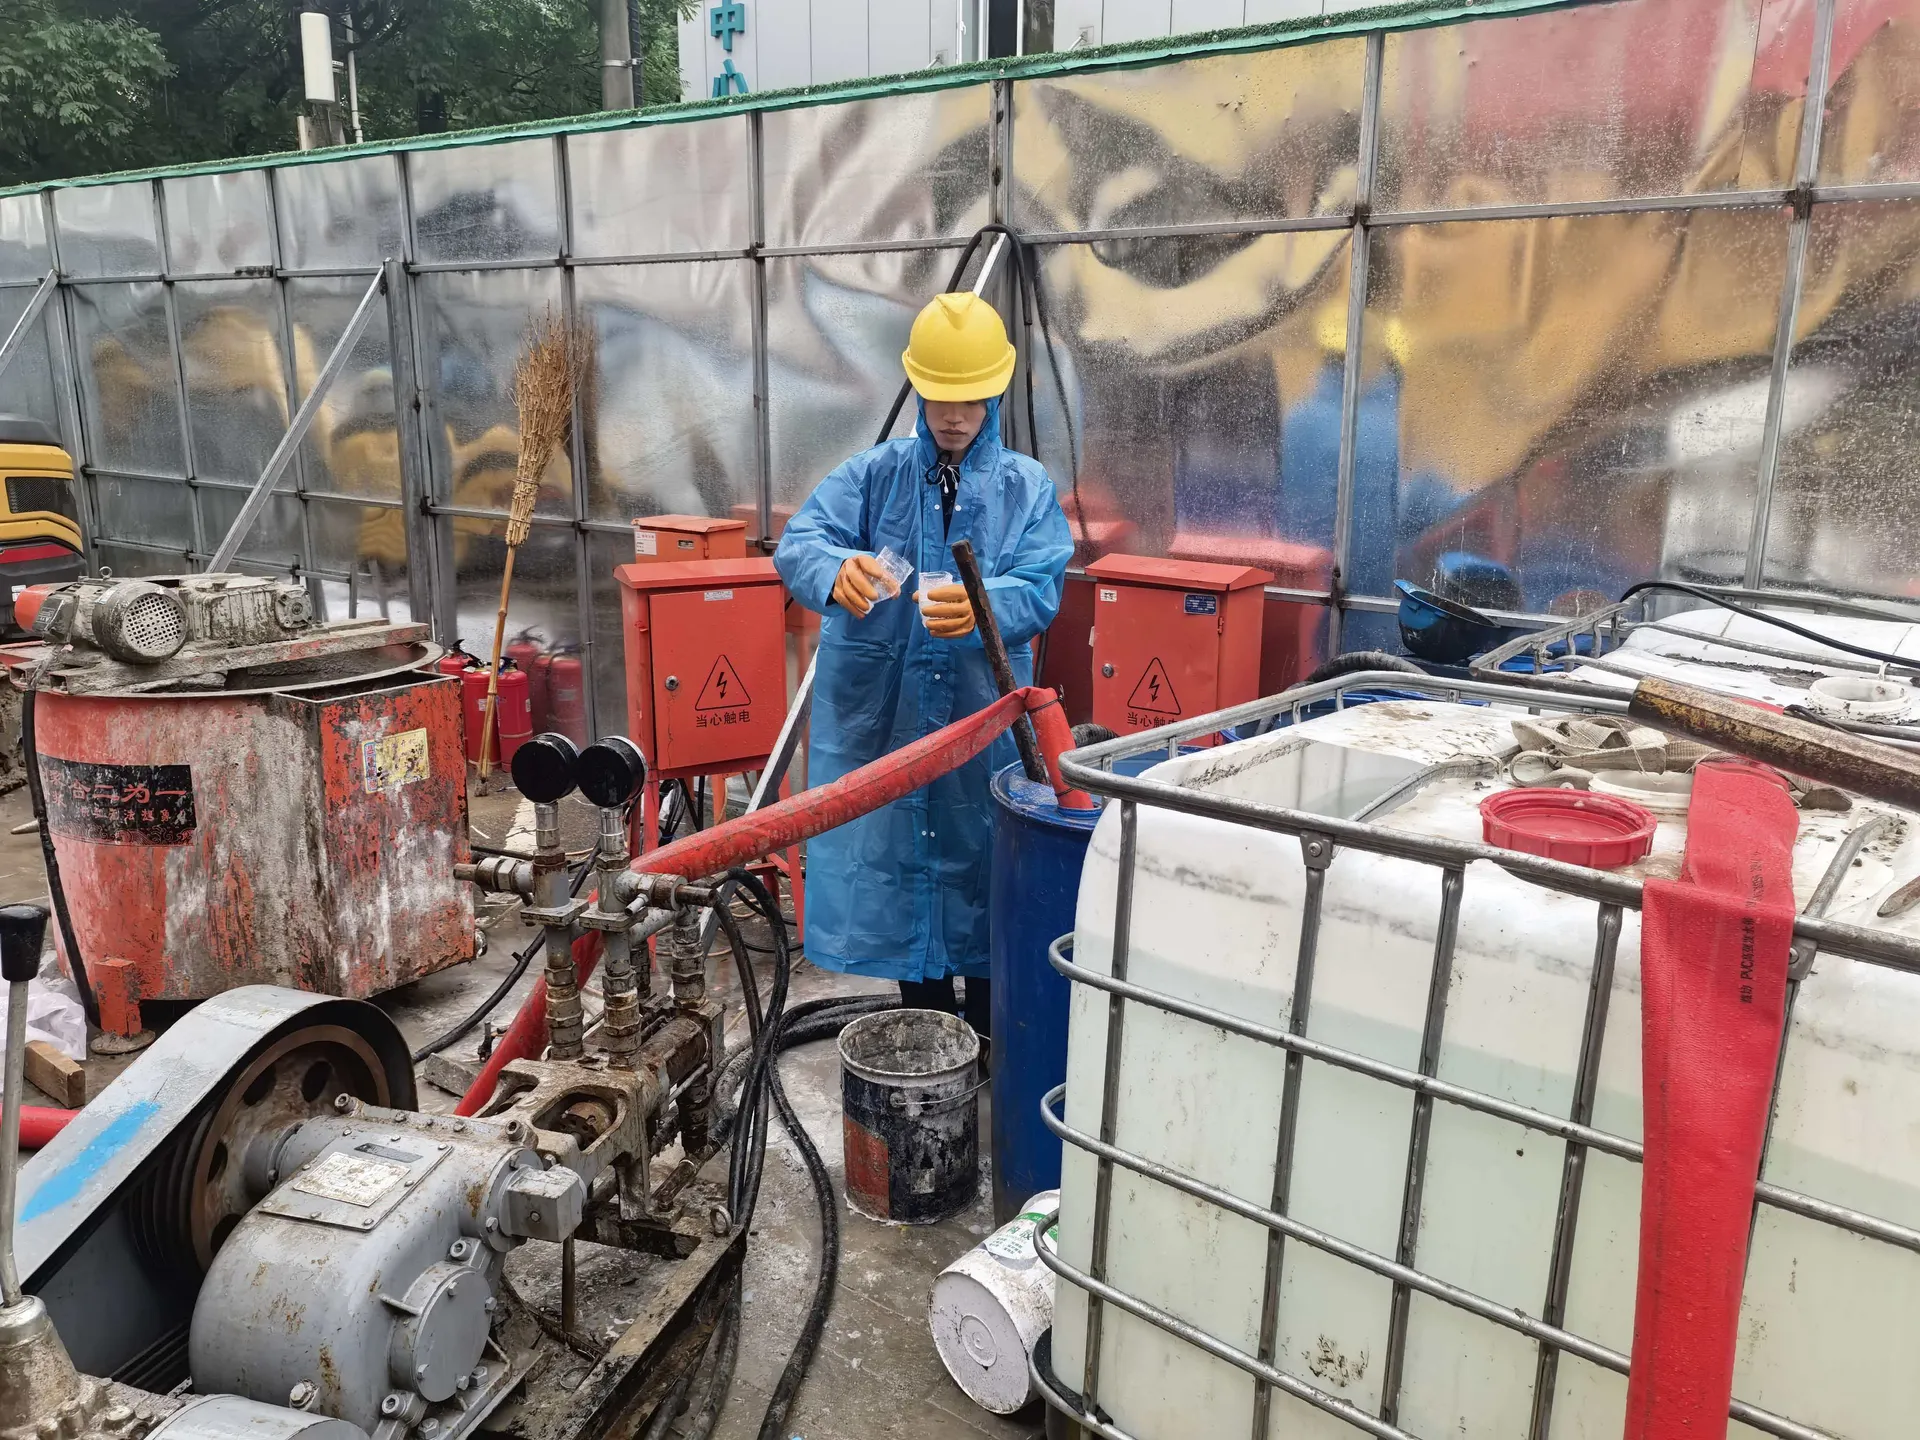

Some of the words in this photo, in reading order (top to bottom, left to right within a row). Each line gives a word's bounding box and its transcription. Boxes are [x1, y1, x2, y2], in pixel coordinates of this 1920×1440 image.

[696, 710, 751, 728] 当心触电
[69, 779, 186, 803] 合二为一
